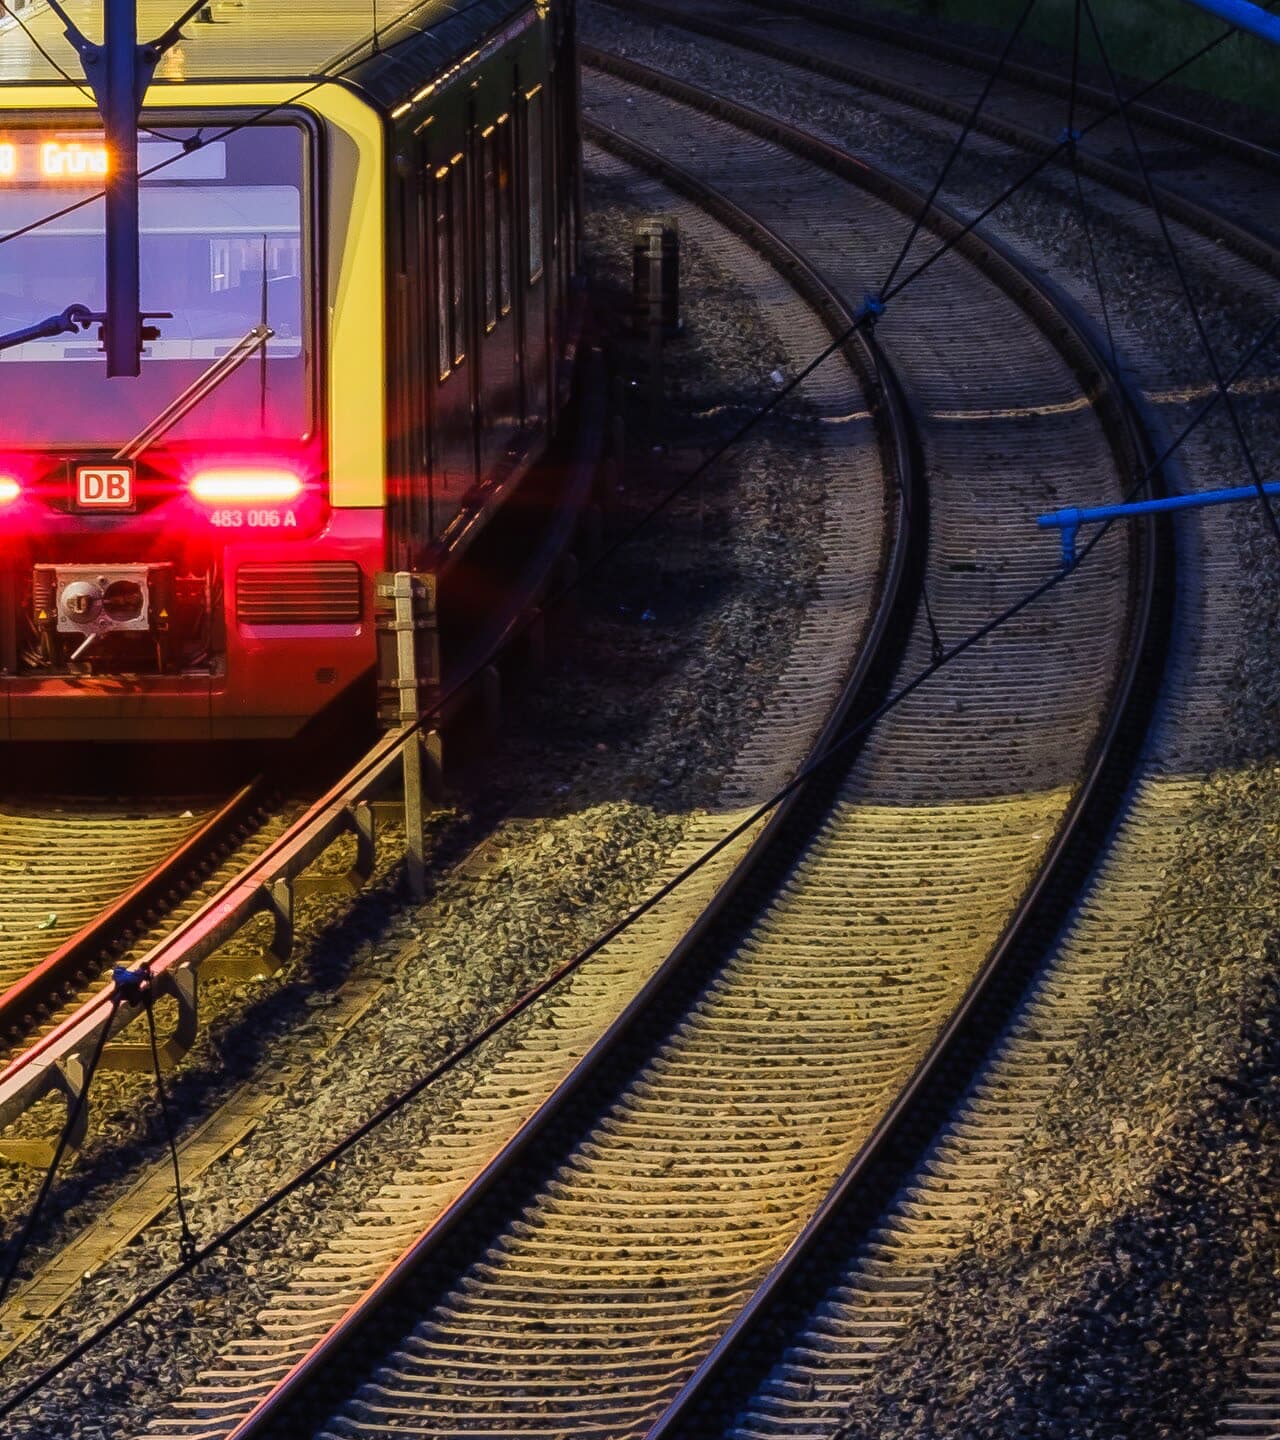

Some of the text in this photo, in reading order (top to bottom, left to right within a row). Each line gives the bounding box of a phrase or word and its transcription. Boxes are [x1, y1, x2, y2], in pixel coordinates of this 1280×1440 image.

[42, 142, 108, 174] Grüna
[84, 473, 126, 500] DB
[209, 510, 297, 528] 483 006 A
